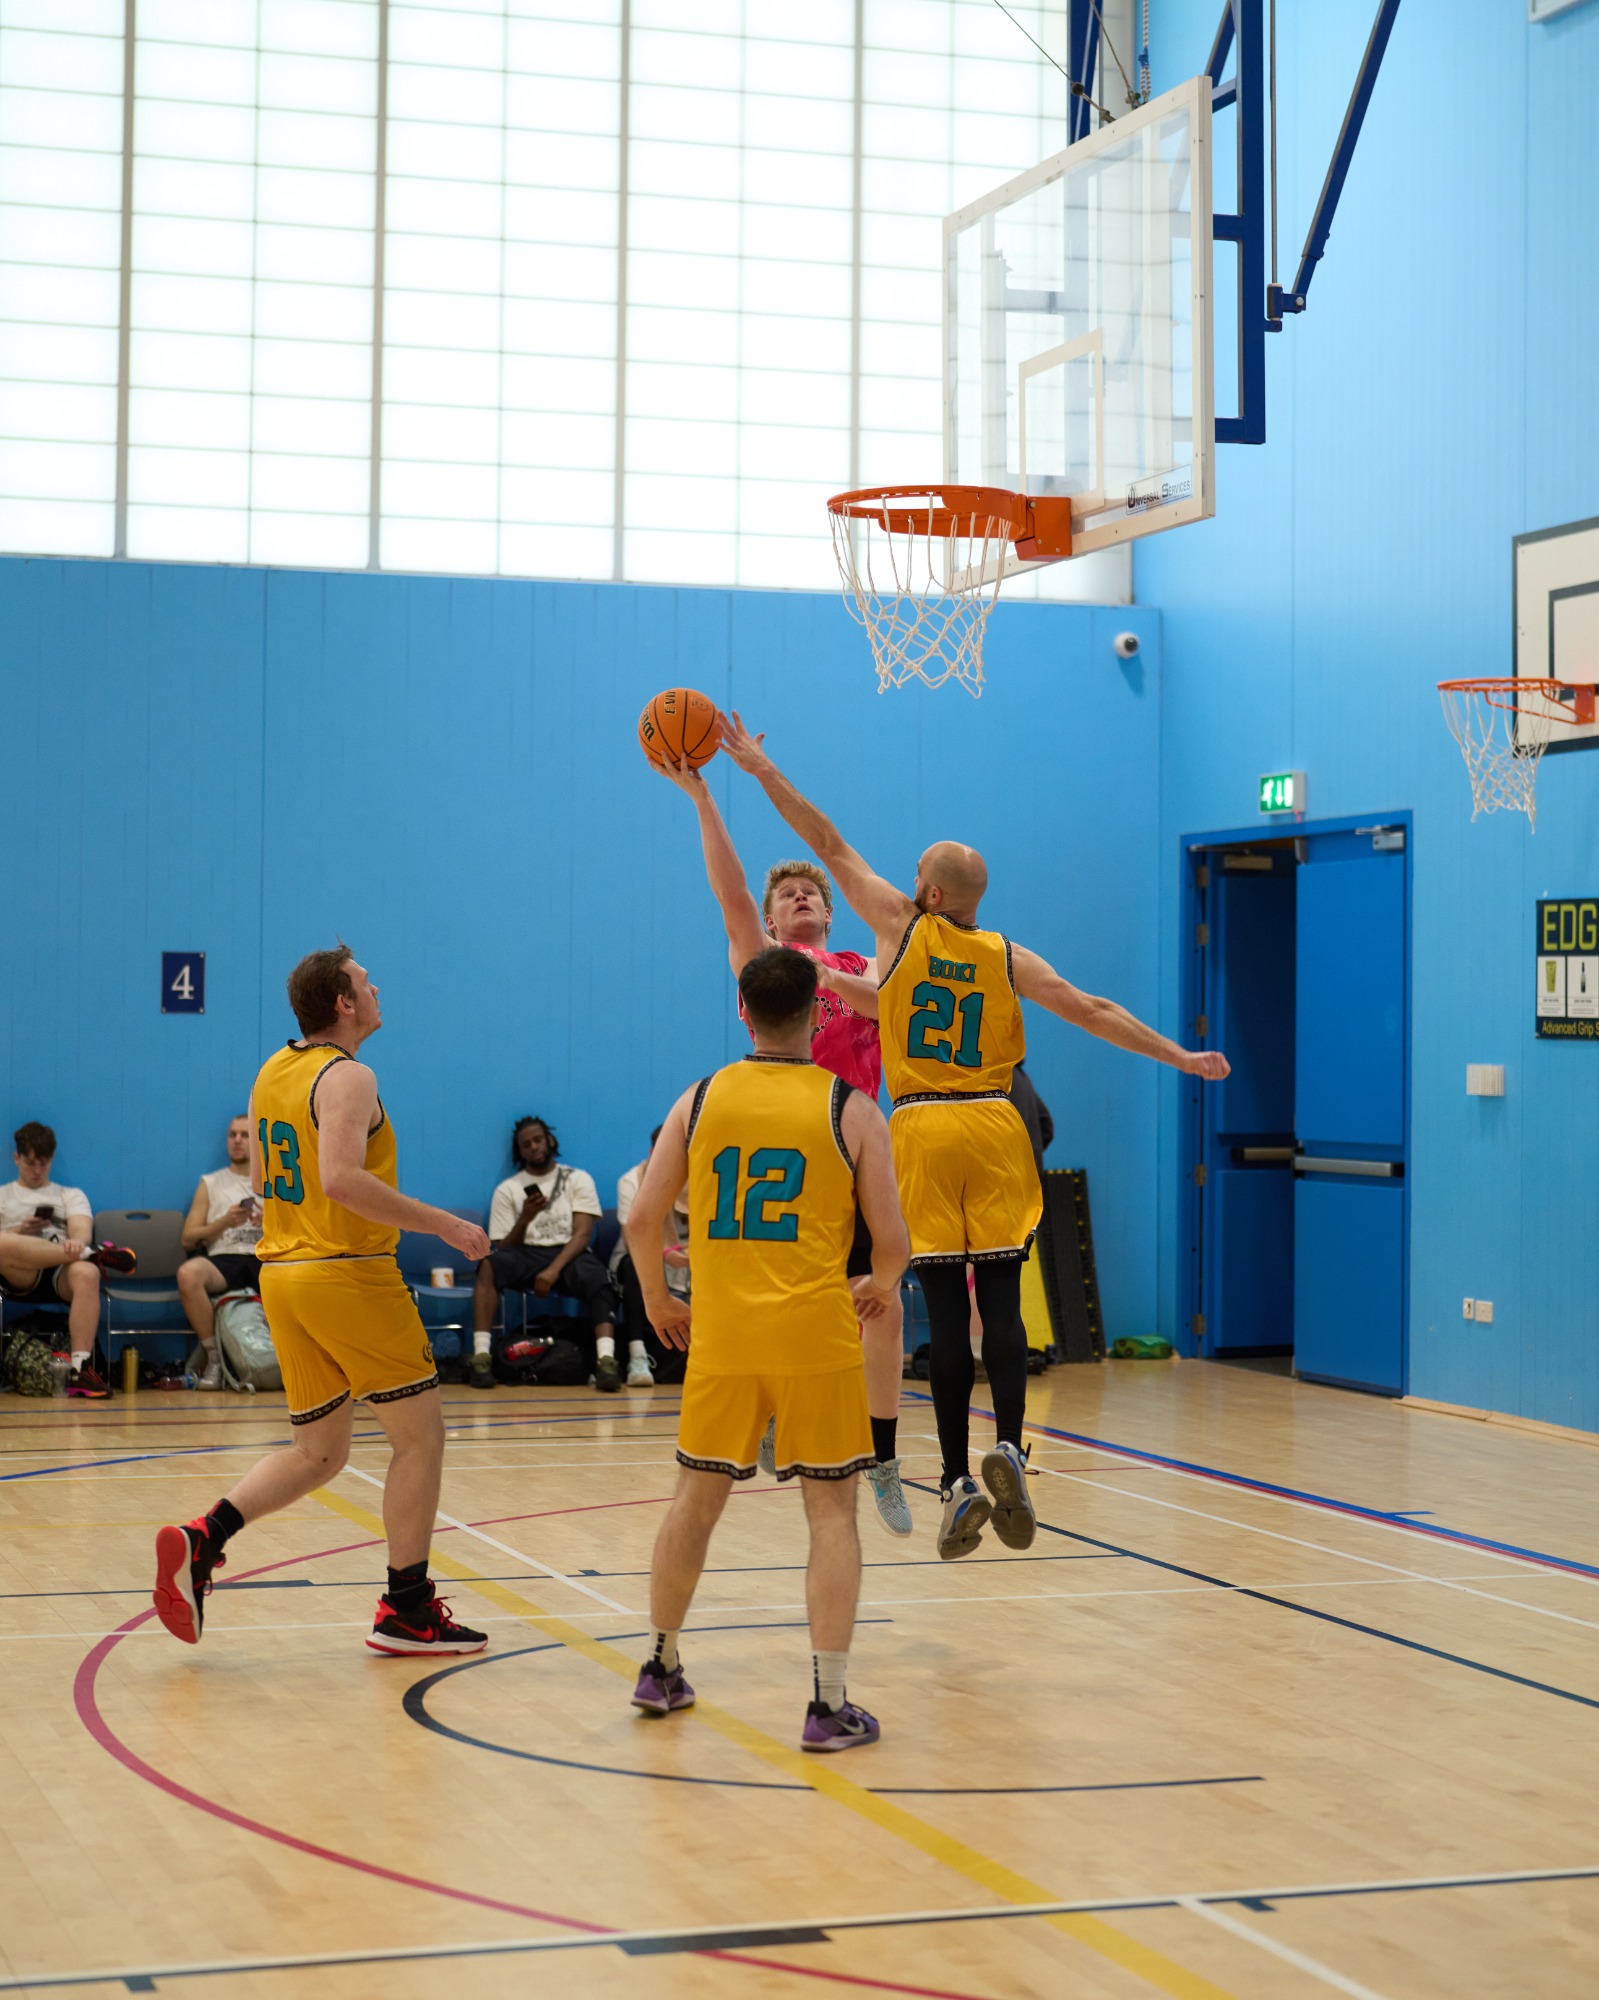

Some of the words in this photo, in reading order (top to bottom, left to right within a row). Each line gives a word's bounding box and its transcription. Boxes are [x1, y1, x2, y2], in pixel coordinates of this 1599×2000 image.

[171, 964, 194, 1000] 4
[929, 955, 977, 983] BOKI
[907, 981, 985, 1067] 21
[1541, 1020, 1577, 1035] Advanced
[1577, 1020, 1594, 1039] Grip
[258, 1117, 305, 1206] 13
[708, 1145, 807, 1243] 12
